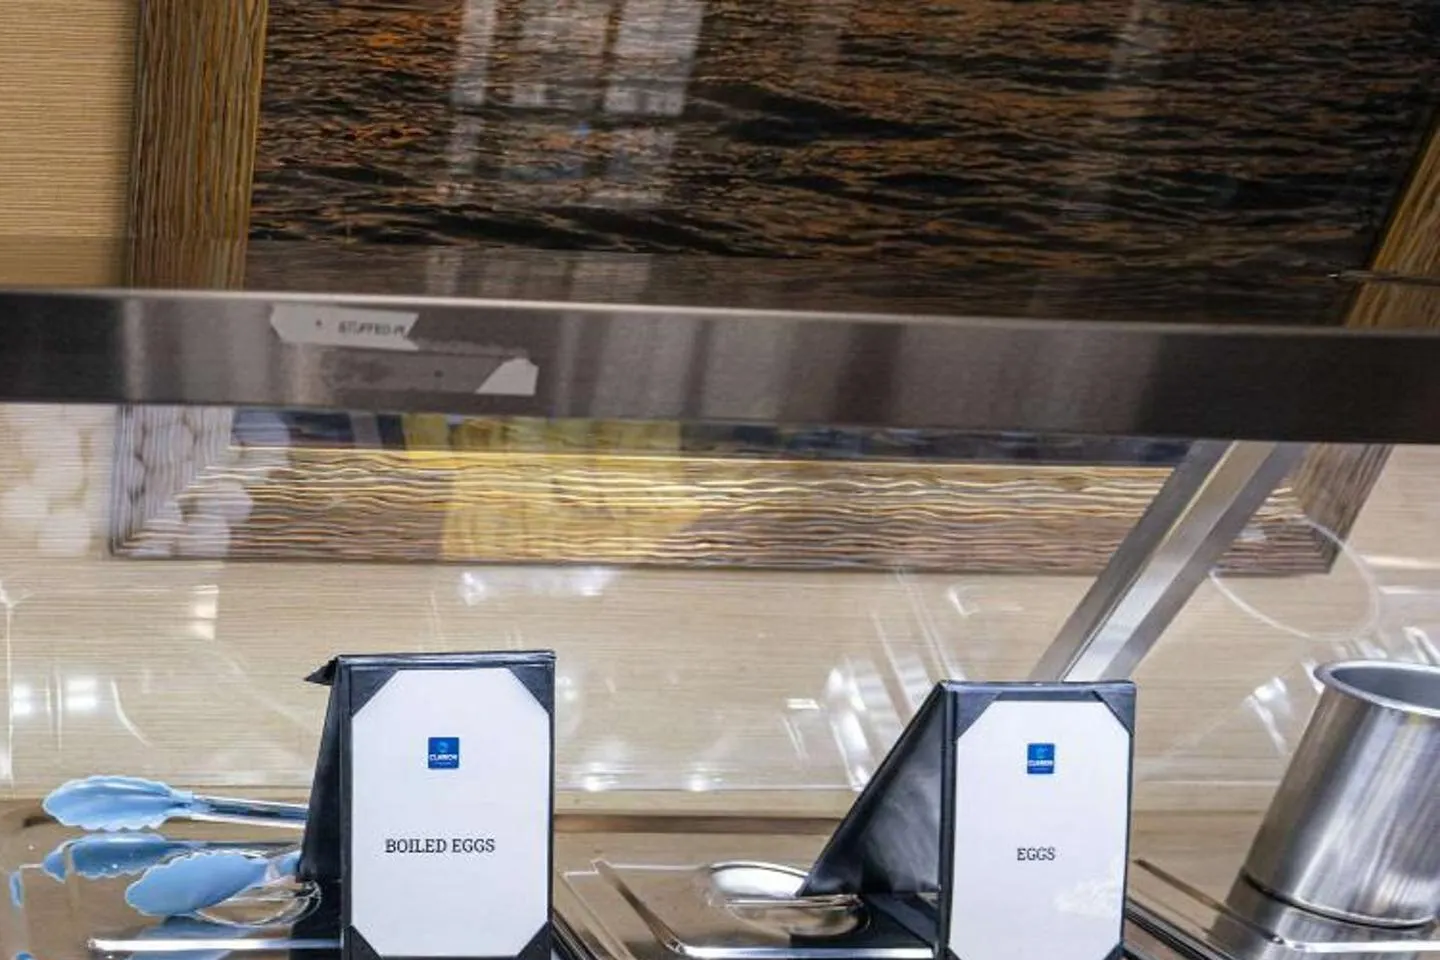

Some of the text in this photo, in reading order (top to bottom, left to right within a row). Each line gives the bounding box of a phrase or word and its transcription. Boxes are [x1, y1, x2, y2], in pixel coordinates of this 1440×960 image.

[385, 838, 495, 853] BOILED EGGS
[1016, 848, 1055, 861] EGGS
